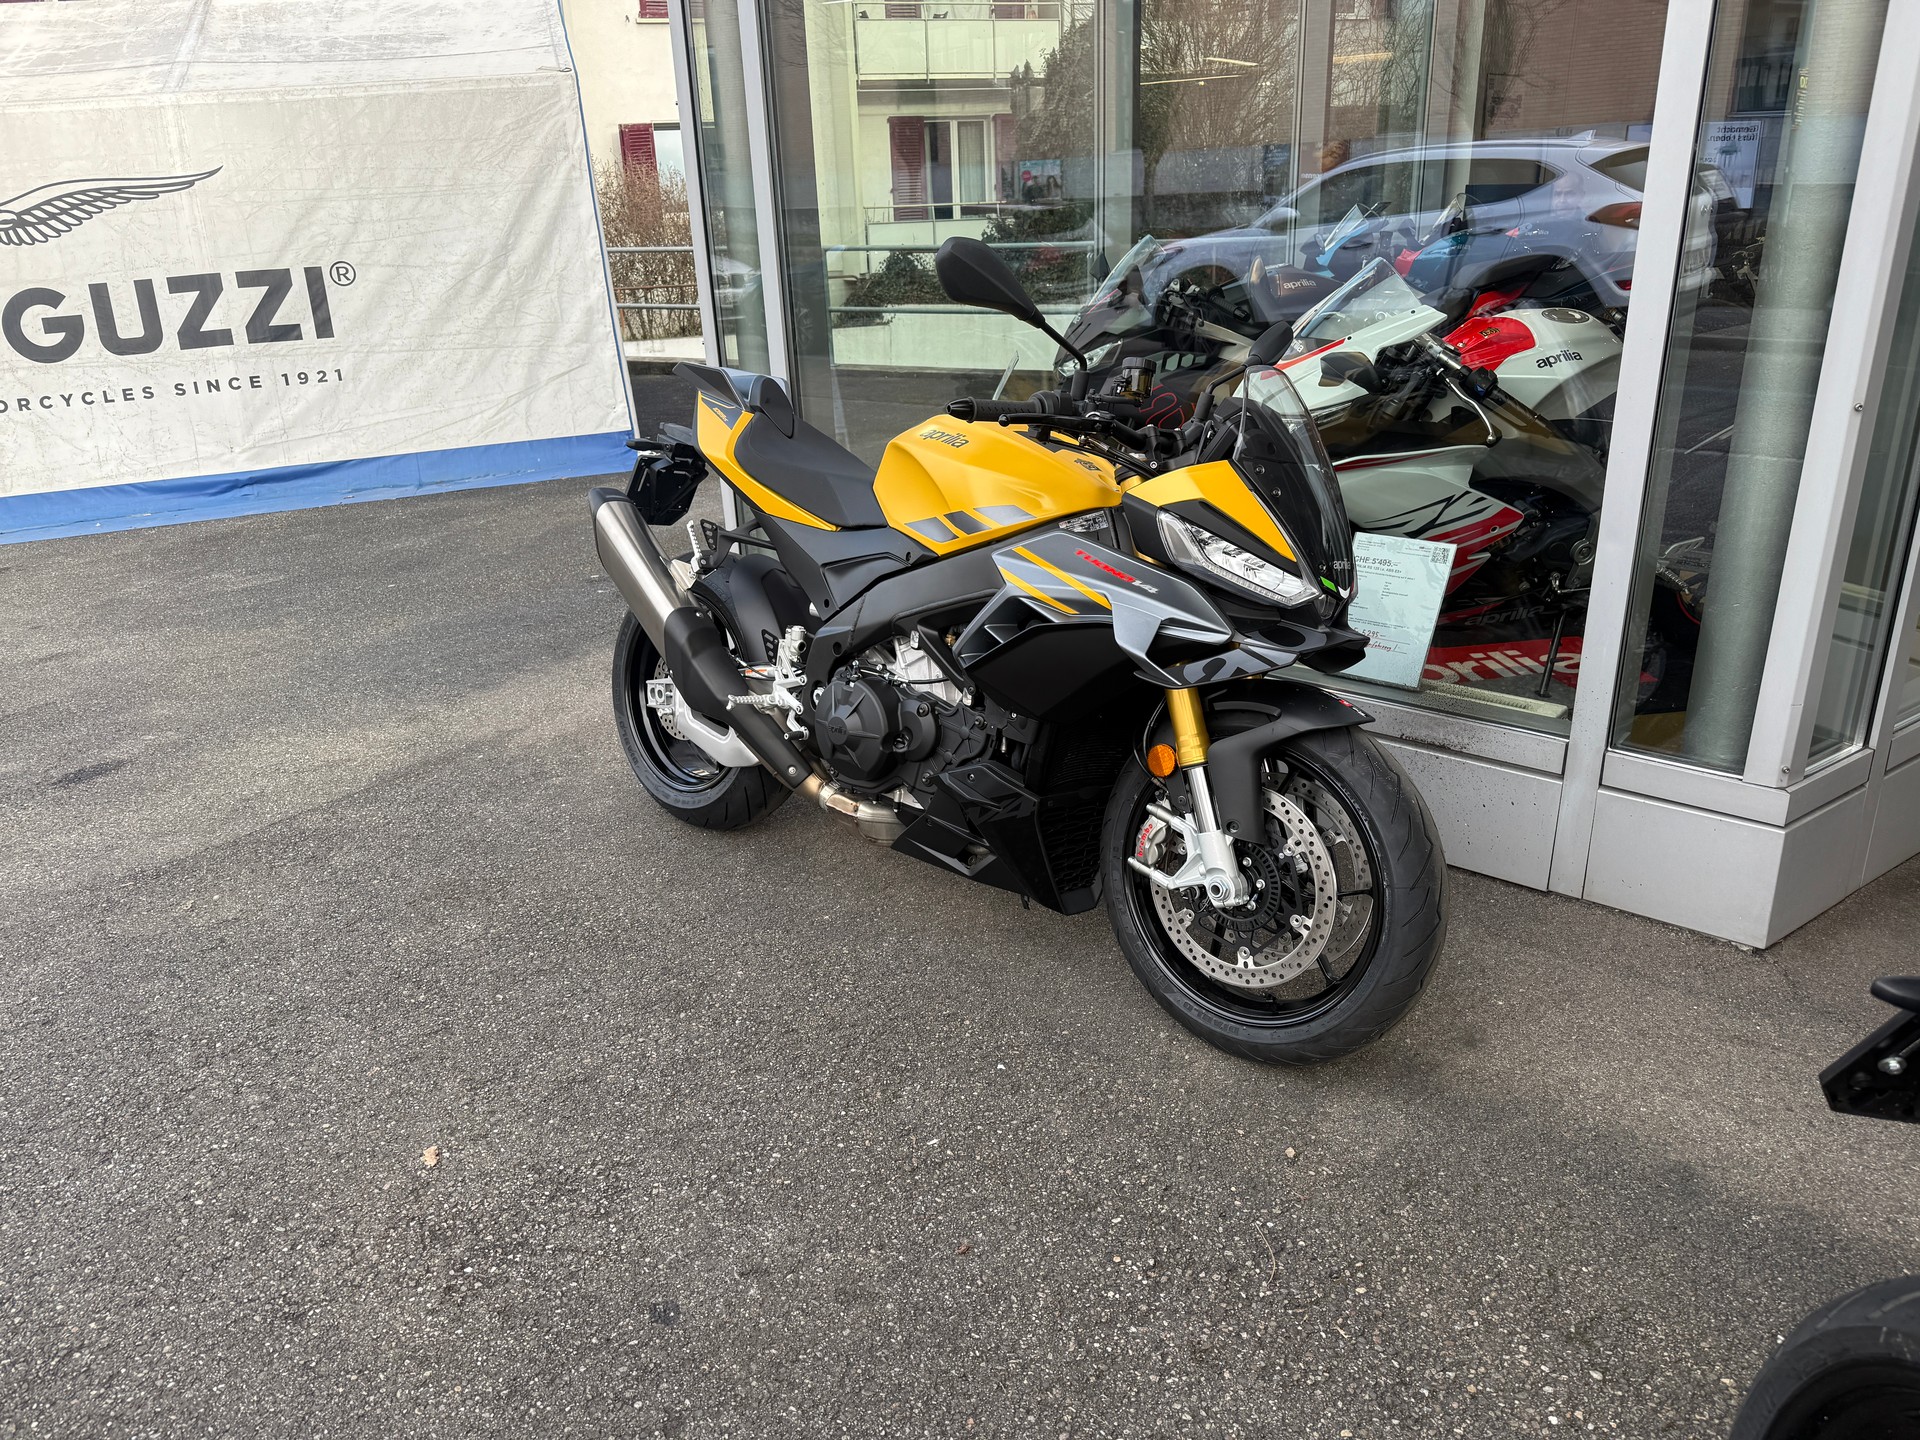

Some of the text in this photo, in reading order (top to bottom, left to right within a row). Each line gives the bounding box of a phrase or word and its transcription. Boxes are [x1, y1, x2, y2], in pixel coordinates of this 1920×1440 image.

[1283, 278, 1316, 290] aprilia
[1536, 350, 1583, 369] aprilia
[174, 374, 262, 396] SINCE
[281, 368, 343, 386] 1921
[919, 428, 969, 449] aprilia
[1465, 604, 1545, 626] aprilia
[1137, 823, 1153, 857] brembo
